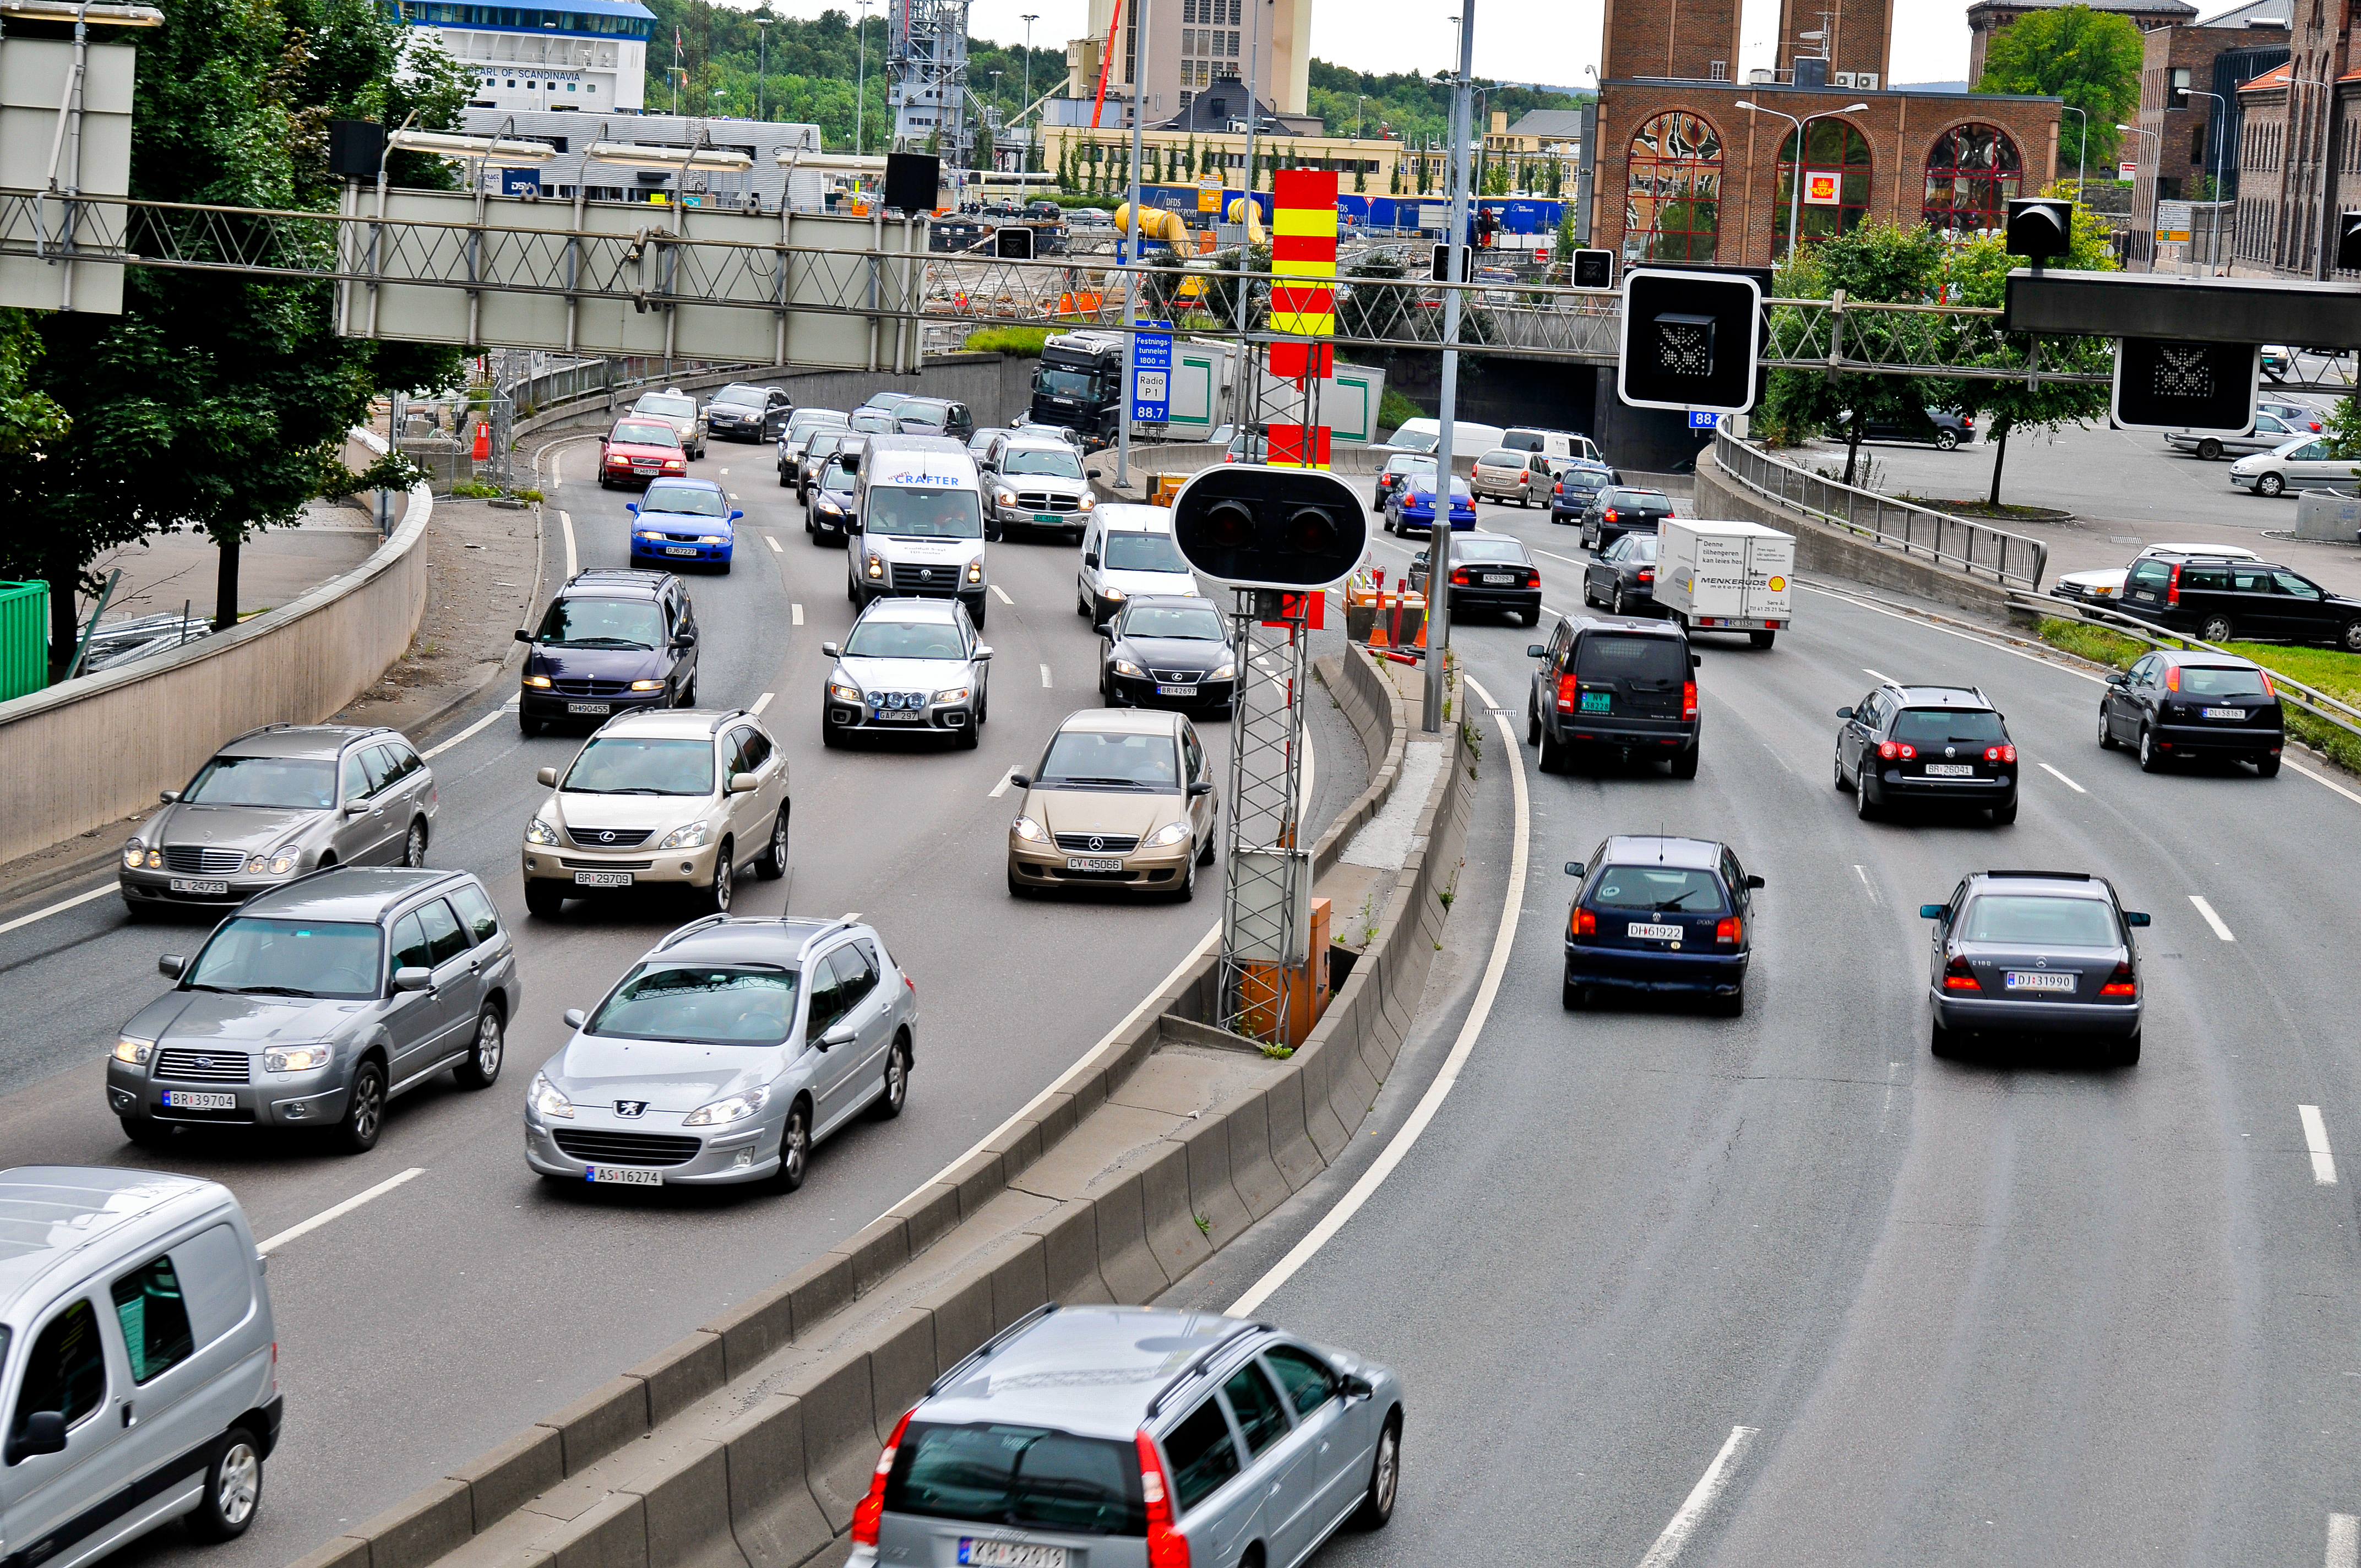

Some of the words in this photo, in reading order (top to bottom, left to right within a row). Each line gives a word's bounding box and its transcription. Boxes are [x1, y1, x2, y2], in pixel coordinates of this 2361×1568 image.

[469, 67, 498, 76] PEARL
[502, 68, 514, 77] OF
[519, 70, 580, 81] SCANDINAVIA
[1166, 198, 1180, 206] DFDS
[1136, 337, 1170, 346] Festnings-
[1140, 376, 1163, 385] Radio
[1145, 388, 1151, 396] P
[1696, 413, 1719, 425] 88,
[895, 475, 959, 486] CRAFTER
[1701, 578, 1766, 586] MENKERUDS
[1928, 765, 1940, 773] BR
[1070, 858, 1082, 868] CV
[1089, 859, 1119, 869] 45066
[578, 873, 591, 883] BR
[596, 874, 629, 884] 29709
[2019, 974, 2031, 985] DJ
[2037, 976, 2070, 987] 31990
[173, 1093, 188, 1106] BR
[195, 1095, 233, 1107] 39704
[598, 1169, 614, 1179] AS
[621, 1170, 659, 1183] 16274
